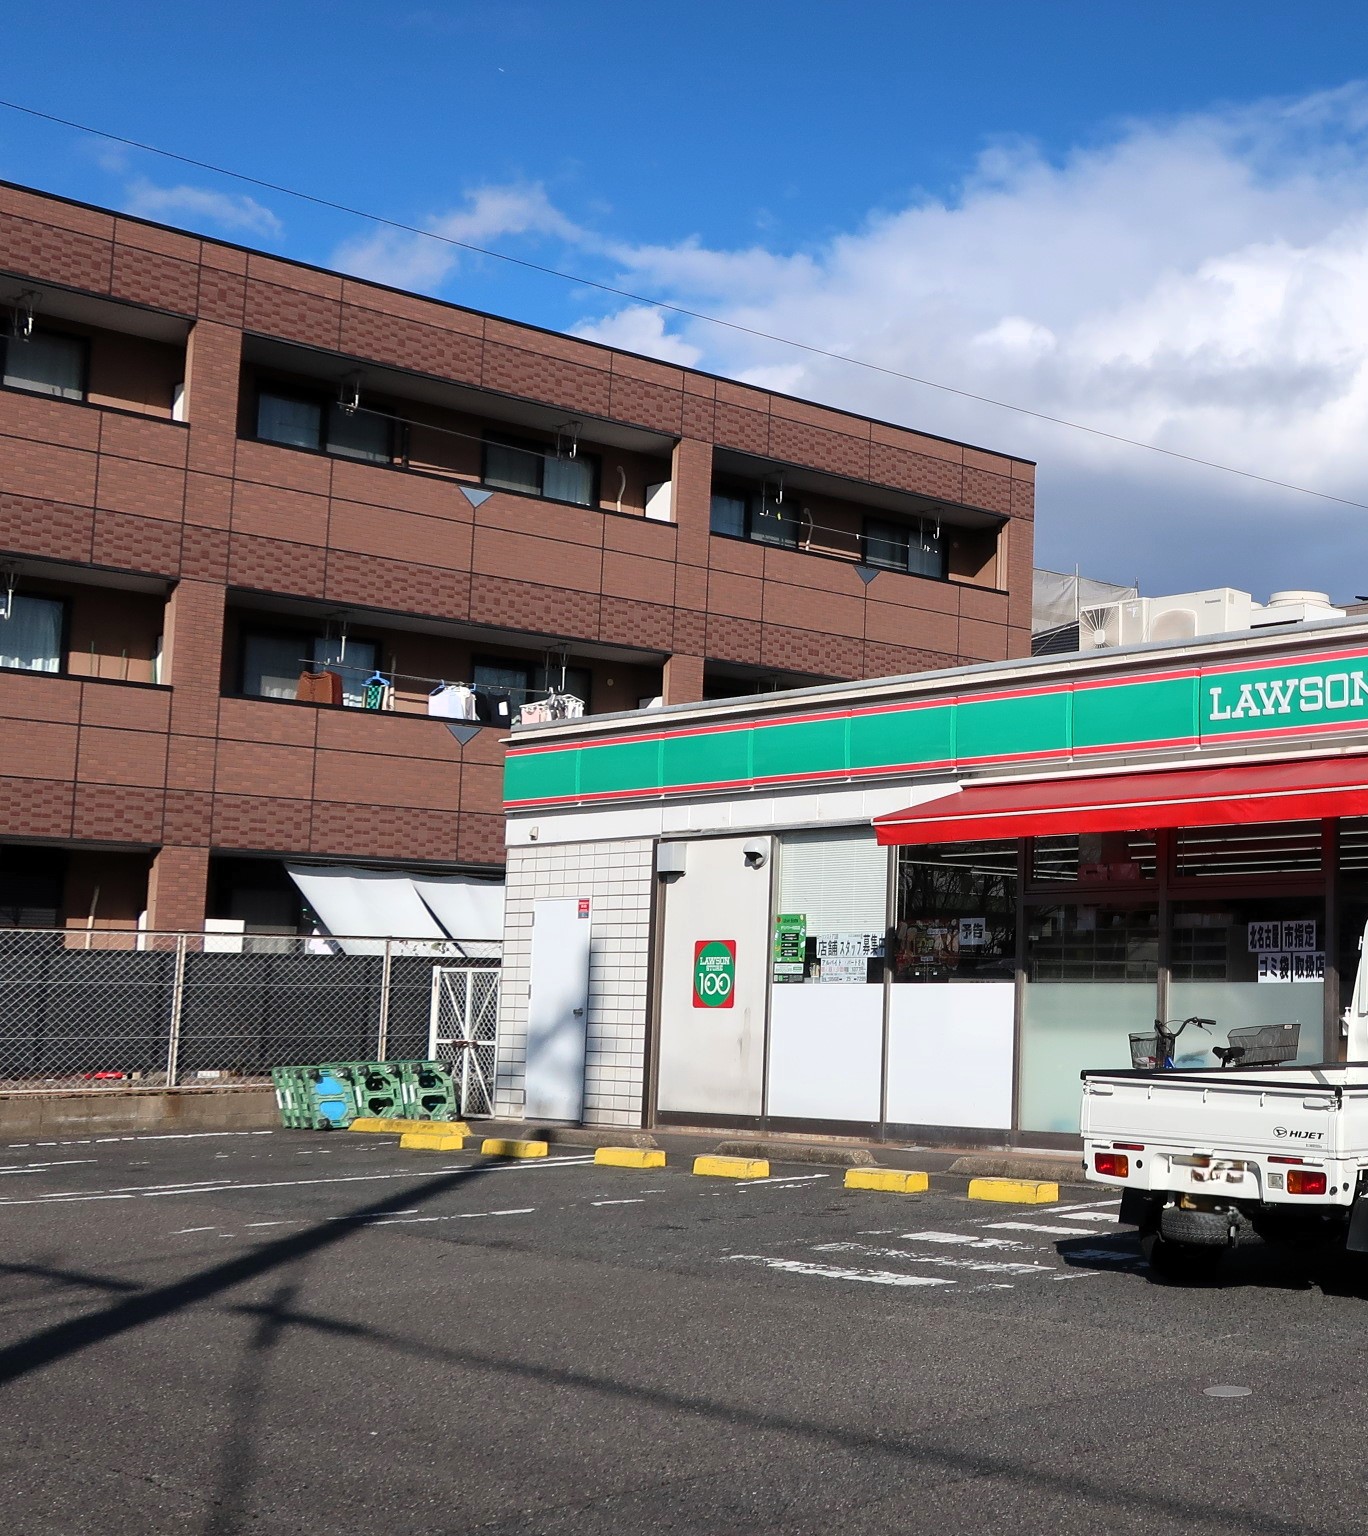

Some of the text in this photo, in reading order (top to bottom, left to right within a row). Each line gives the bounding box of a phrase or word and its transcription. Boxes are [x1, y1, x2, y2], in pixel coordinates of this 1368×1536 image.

[962, 922, 983, 940] 予告
[699, 956, 730, 966] LAWSON
[698, 972, 731, 996] 100
[1289, 1130, 1325, 1139] HIJET
